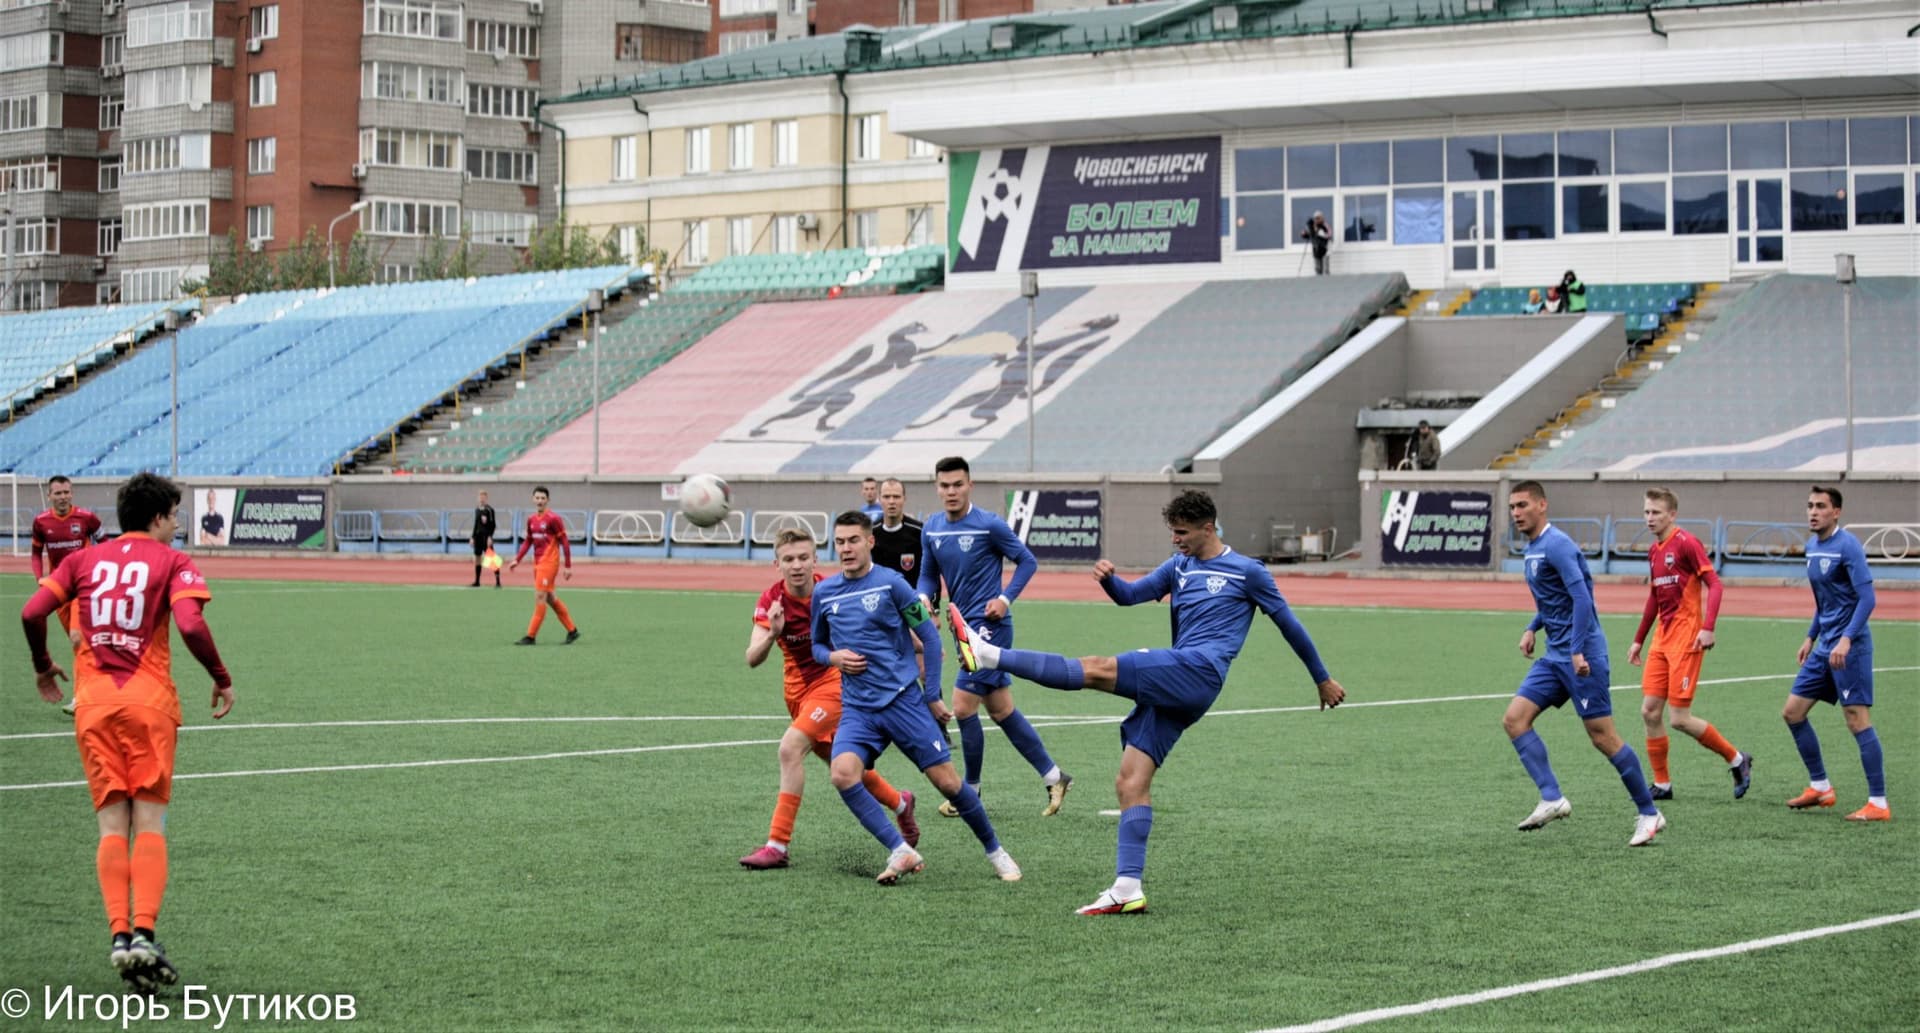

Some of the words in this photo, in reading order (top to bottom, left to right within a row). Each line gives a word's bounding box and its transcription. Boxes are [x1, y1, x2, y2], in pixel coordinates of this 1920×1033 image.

[1074, 153, 1208, 184] НОВОСИБИРСК
[1093, 176, 1159, 187] ФУТБОЛЬНЫЙ
[1163, 174, 1188, 183] КЛУБ
[1066, 199, 1200, 232] БОЛЕЕМ
[1050, 236, 1079, 257] ЗА
[1082, 232, 1171, 256] НАШИХ!
[242, 503, 322, 522] ПОДДЕРЖИ
[1411, 514, 1488, 532] ИГРАЕМ
[1404, 535, 1443, 552] ДЛЯ
[90, 560, 149, 631] 23
